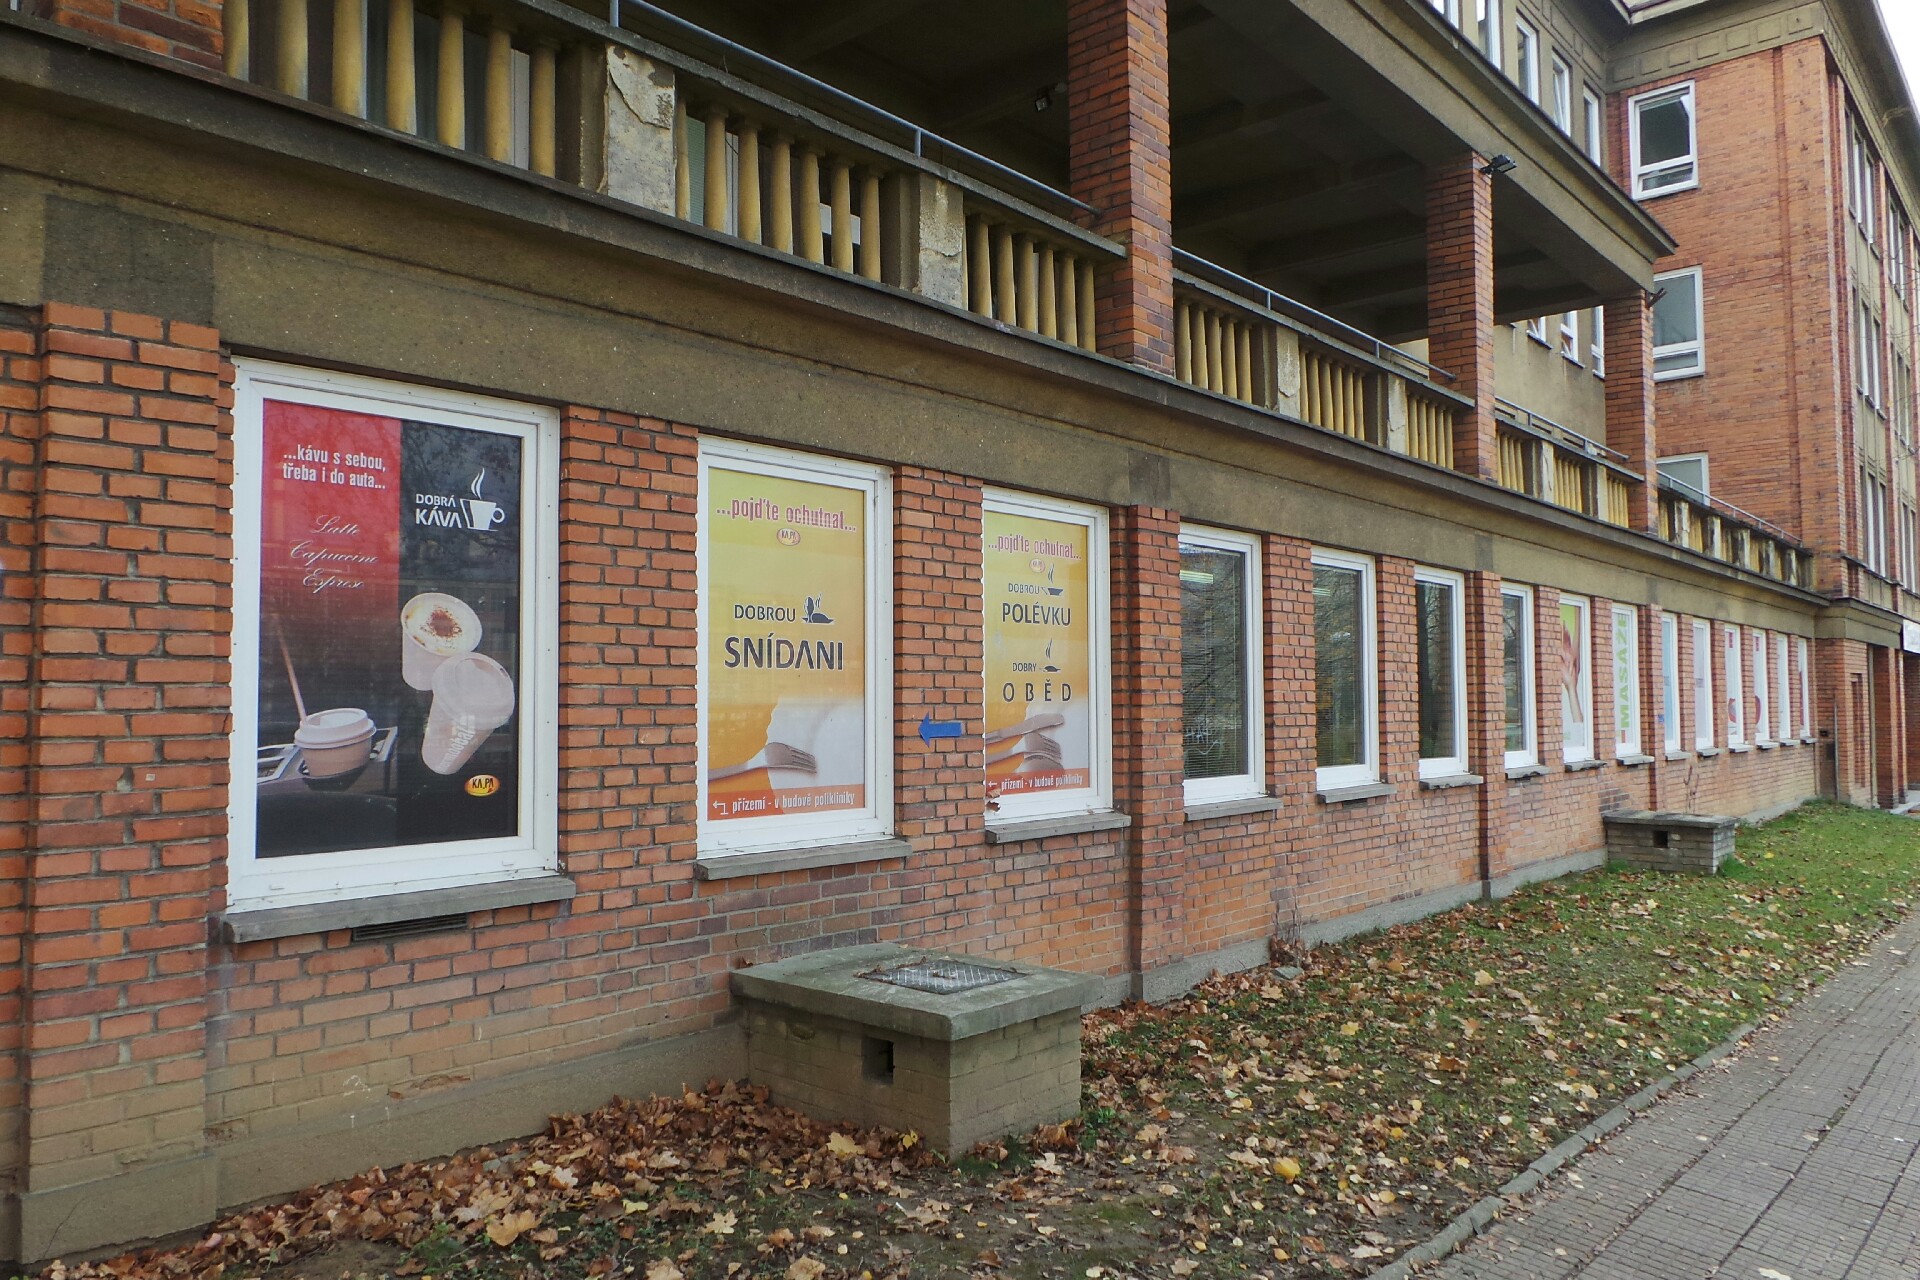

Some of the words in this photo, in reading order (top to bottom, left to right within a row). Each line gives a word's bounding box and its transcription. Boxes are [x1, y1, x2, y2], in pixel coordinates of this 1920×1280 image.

[283, 444, 328, 464] ...kávu
[333, 454, 341, 465] s
[345, 452, 386, 472] sebou,
[283, 463, 317, 482] třeba
[322, 467, 326, 483] i
[330, 468, 345, 485] do
[350, 472, 386, 489] auta...
[415, 493, 456, 508] DOBRÁ
[309, 515, 361, 536] Latte
[415, 506, 462, 529] KÁVA
[716, 497, 779, 522] ...pojďte
[786, 504, 857, 532] ochutnat...
[1034, 536, 1082, 560] ochutnat...
[1008, 582, 1040, 595] DOBROU
[734, 604, 796, 622] DOBROU
[1002, 601, 1071, 626] POLÉVKU
[724, 633, 844, 671] SNÍDANI
[1001, 778, 1024, 792] přízemí
[1028, 780, 1033, 788] v
[1034, 775, 1054, 787] budově
[732, 797, 766, 814] přízemí
[774, 800, 780, 809] v
[782, 793, 812, 808] budově
[814, 791, 855, 808] polikliniky
